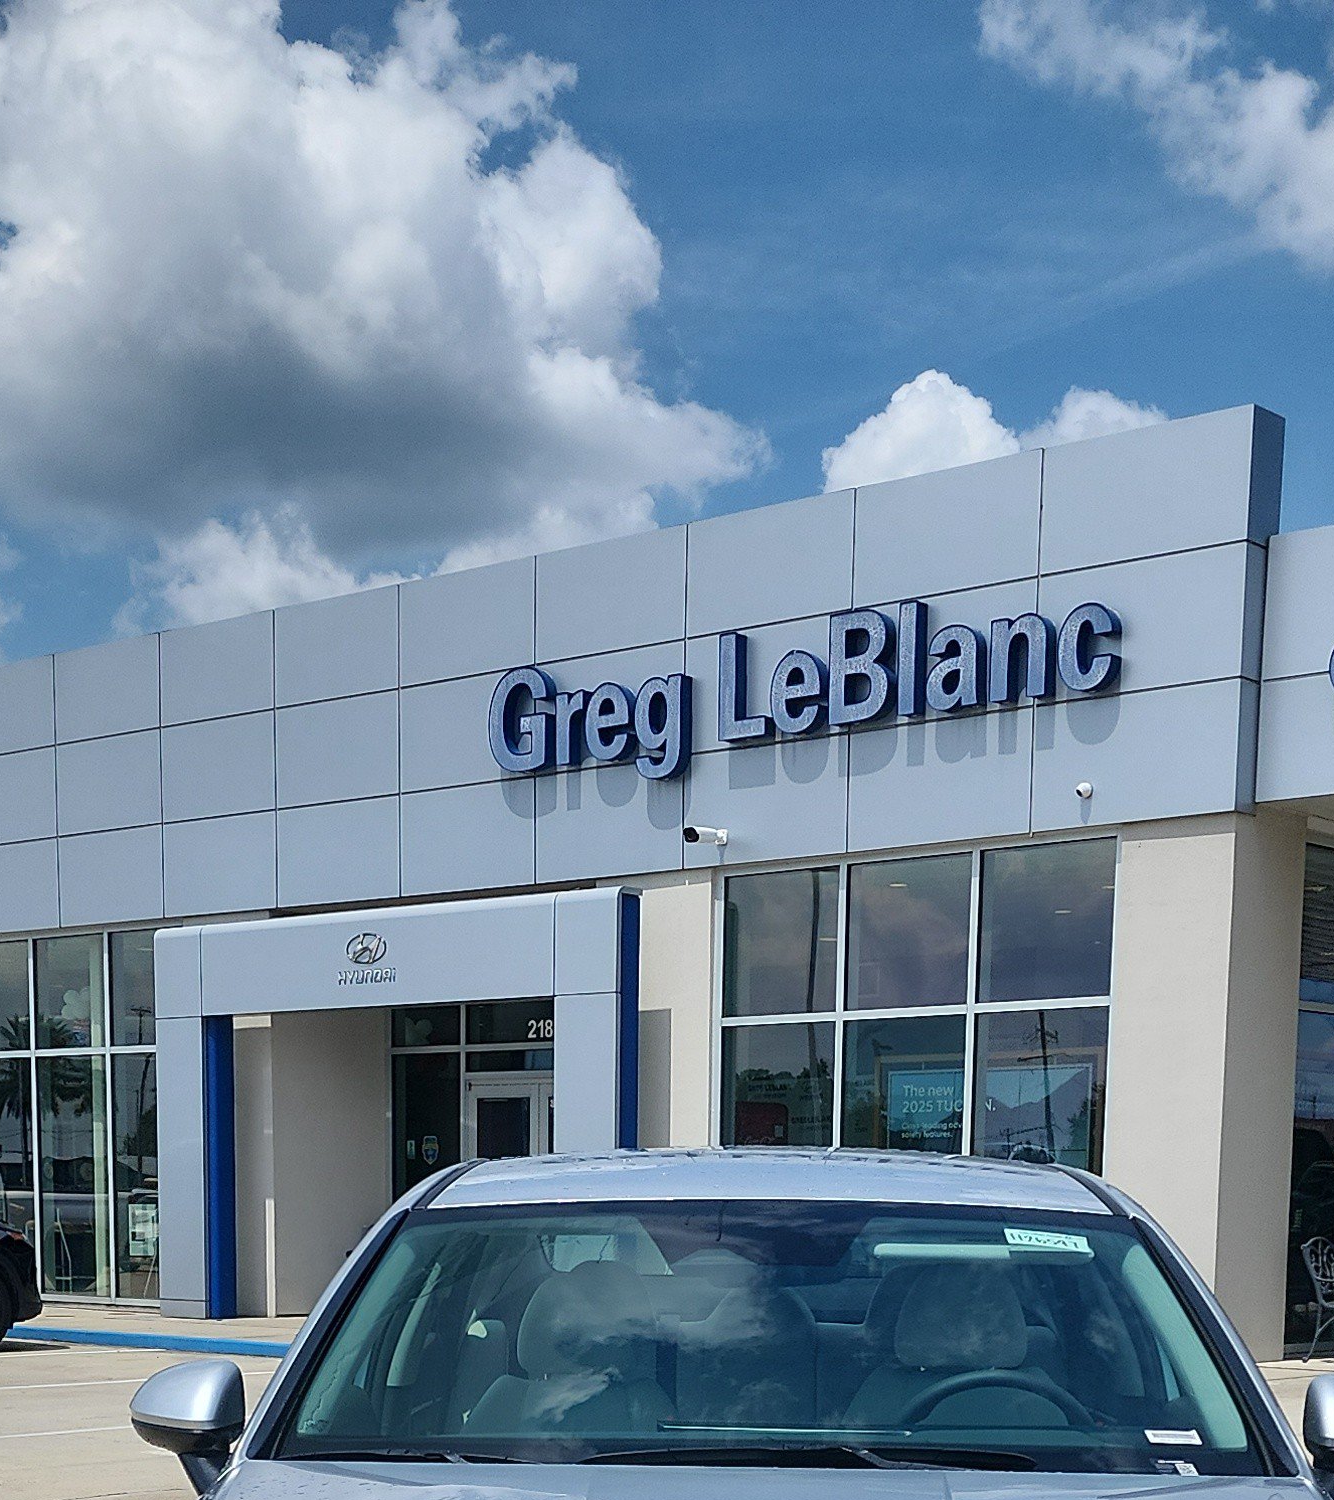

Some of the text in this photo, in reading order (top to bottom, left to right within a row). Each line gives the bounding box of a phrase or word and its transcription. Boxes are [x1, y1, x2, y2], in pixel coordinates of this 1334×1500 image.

[489, 600, 1123, 781] Greg LeBlanc
[338, 967, 396, 985] HYUNDAI
[903, 1084, 954, 1097] The new
[902, 1101, 933, 1113] 2025
